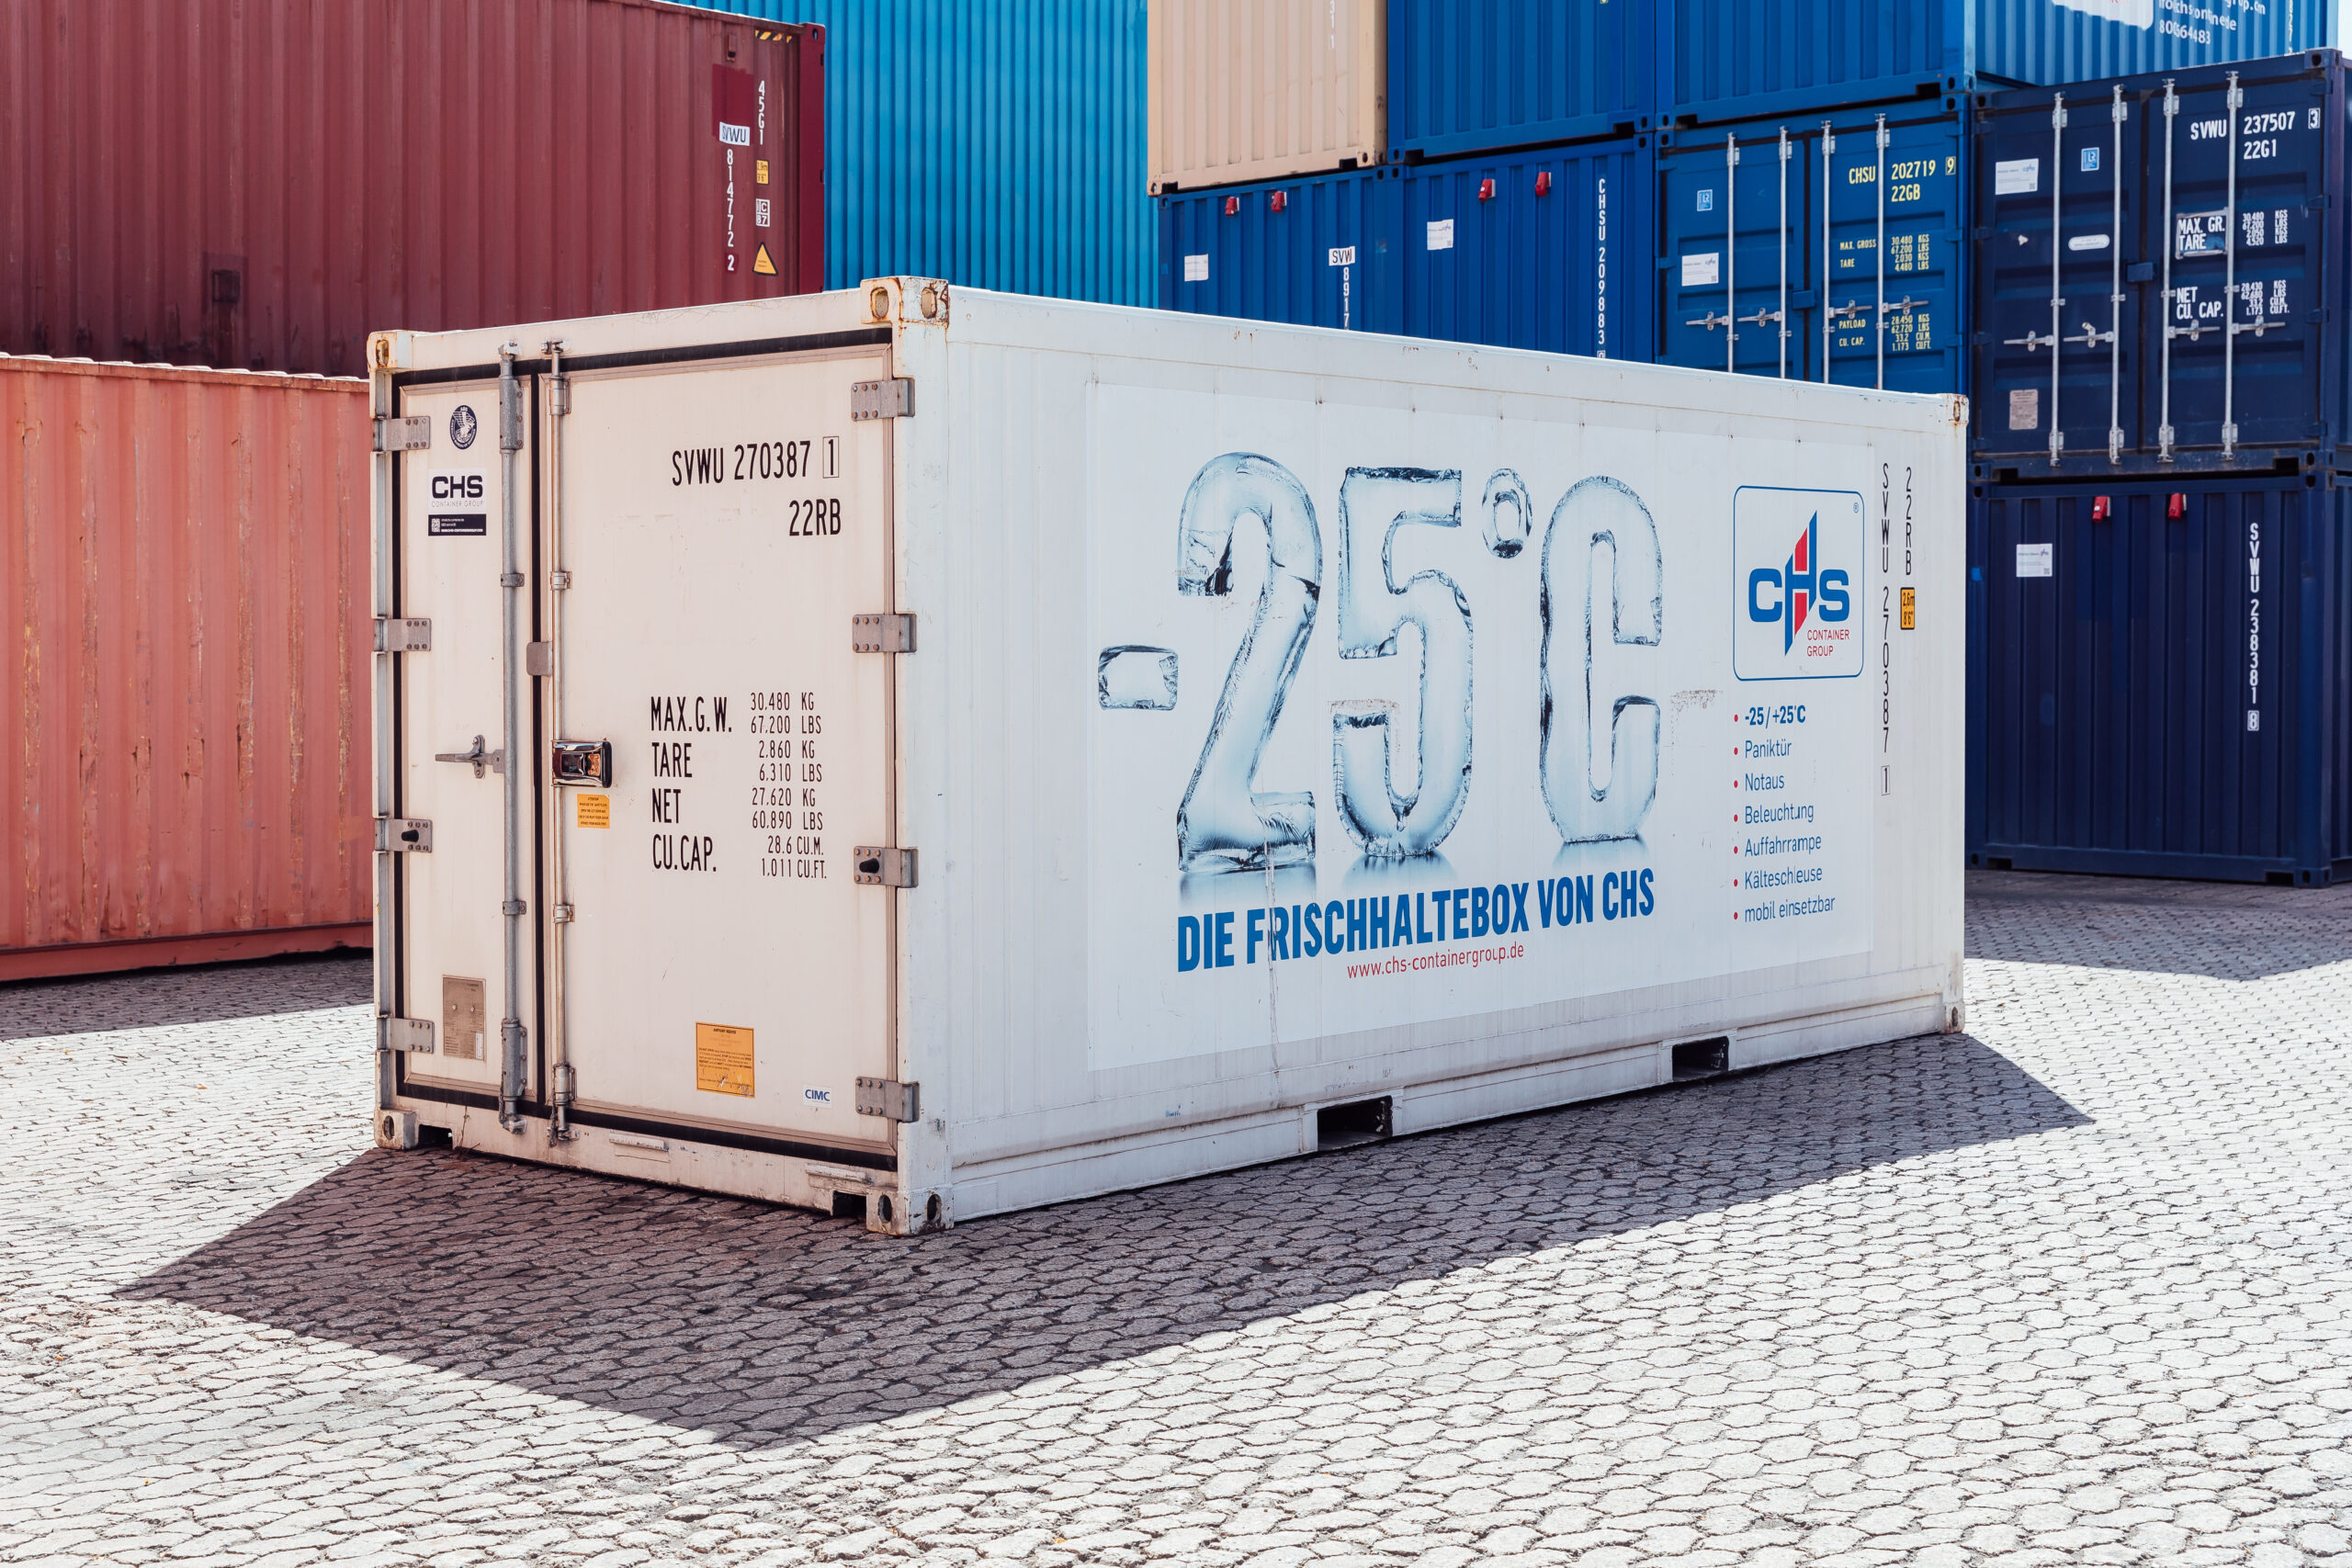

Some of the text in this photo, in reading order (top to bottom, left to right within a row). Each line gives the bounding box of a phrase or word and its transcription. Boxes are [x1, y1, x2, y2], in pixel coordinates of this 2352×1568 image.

[2190, 109, 2319, 140] SVWU 237507 3
[2244, 139, 2277, 160] 22G1
[1849, 156, 1955, 185] CHSU 202719 9
[1891, 183, 1921, 202] 22GB
[1598, 178, 1606, 241] CHSU
[2177, 216, 2225, 234] MAX. GR.
[1839, 239, 1876, 251] MAX. GROSS
[1917, 234, 1929, 243] KGS
[1917, 243, 1929, 253] LBS
[2179, 233, 2207, 251] TARE
[1840, 258, 1855, 268] TARE
[1917, 252, 1929, 262] KGS
[1917, 261, 1929, 270] LBS
[1598, 246, 1606, 345] 209883
[2177, 287, 2198, 303] NET
[2177, 300, 2224, 320] CU. CAP.
[1838, 319, 1866, 329] PAYLOAD
[1918, 322, 1929, 332] LBS
[1838, 337, 1865, 347] CU. CAP.
[672, 447, 724, 486] SVWU
[734, 440, 811, 479] 270387
[432, 475, 483, 499] CHS
[788, 499, 842, 536] 22RB
[1882, 462, 1890, 573] SVWU
[1748, 510, 1850, 656] CHS
[1806, 629, 1850, 641] CONTAINER
[2249, 523, 2259, 729] SVWU 238381 8
[1806, 645, 1834, 657] GROUP
[1098, 451, 1663, 872] -25°C
[801, 692, 814, 711] KG
[801, 715, 821, 734] LBS
[802, 740, 815, 759] KG
[1745, 738, 1792, 759] Paniktür
[651, 742, 693, 778] TARE
[802, 763, 822, 783] LBS
[1745, 773, 1785, 792] Notaus
[651, 788, 681, 824] NET
[802, 788, 816, 807] KG
[803, 811, 823, 830] LBS
[1745, 803, 1814, 824] Beleuchtung
[652, 833, 717, 872] CU.CAP.
[767, 835, 823, 855] 28.6 CU.M.
[1745, 835, 1822, 857] Auffahrrampe
[797, 859, 827, 879] CU.FT.
[1745, 866, 1823, 890] Kälteschleuse
[1745, 894, 1836, 923] mobil einsetzbar
[1177, 867, 1655, 973] DIE FRISCHHALTEBOX VON CHS
[1347, 941, 1525, 980] www.chs-containergroup.de
[805, 1089, 831, 1101] CIMC
